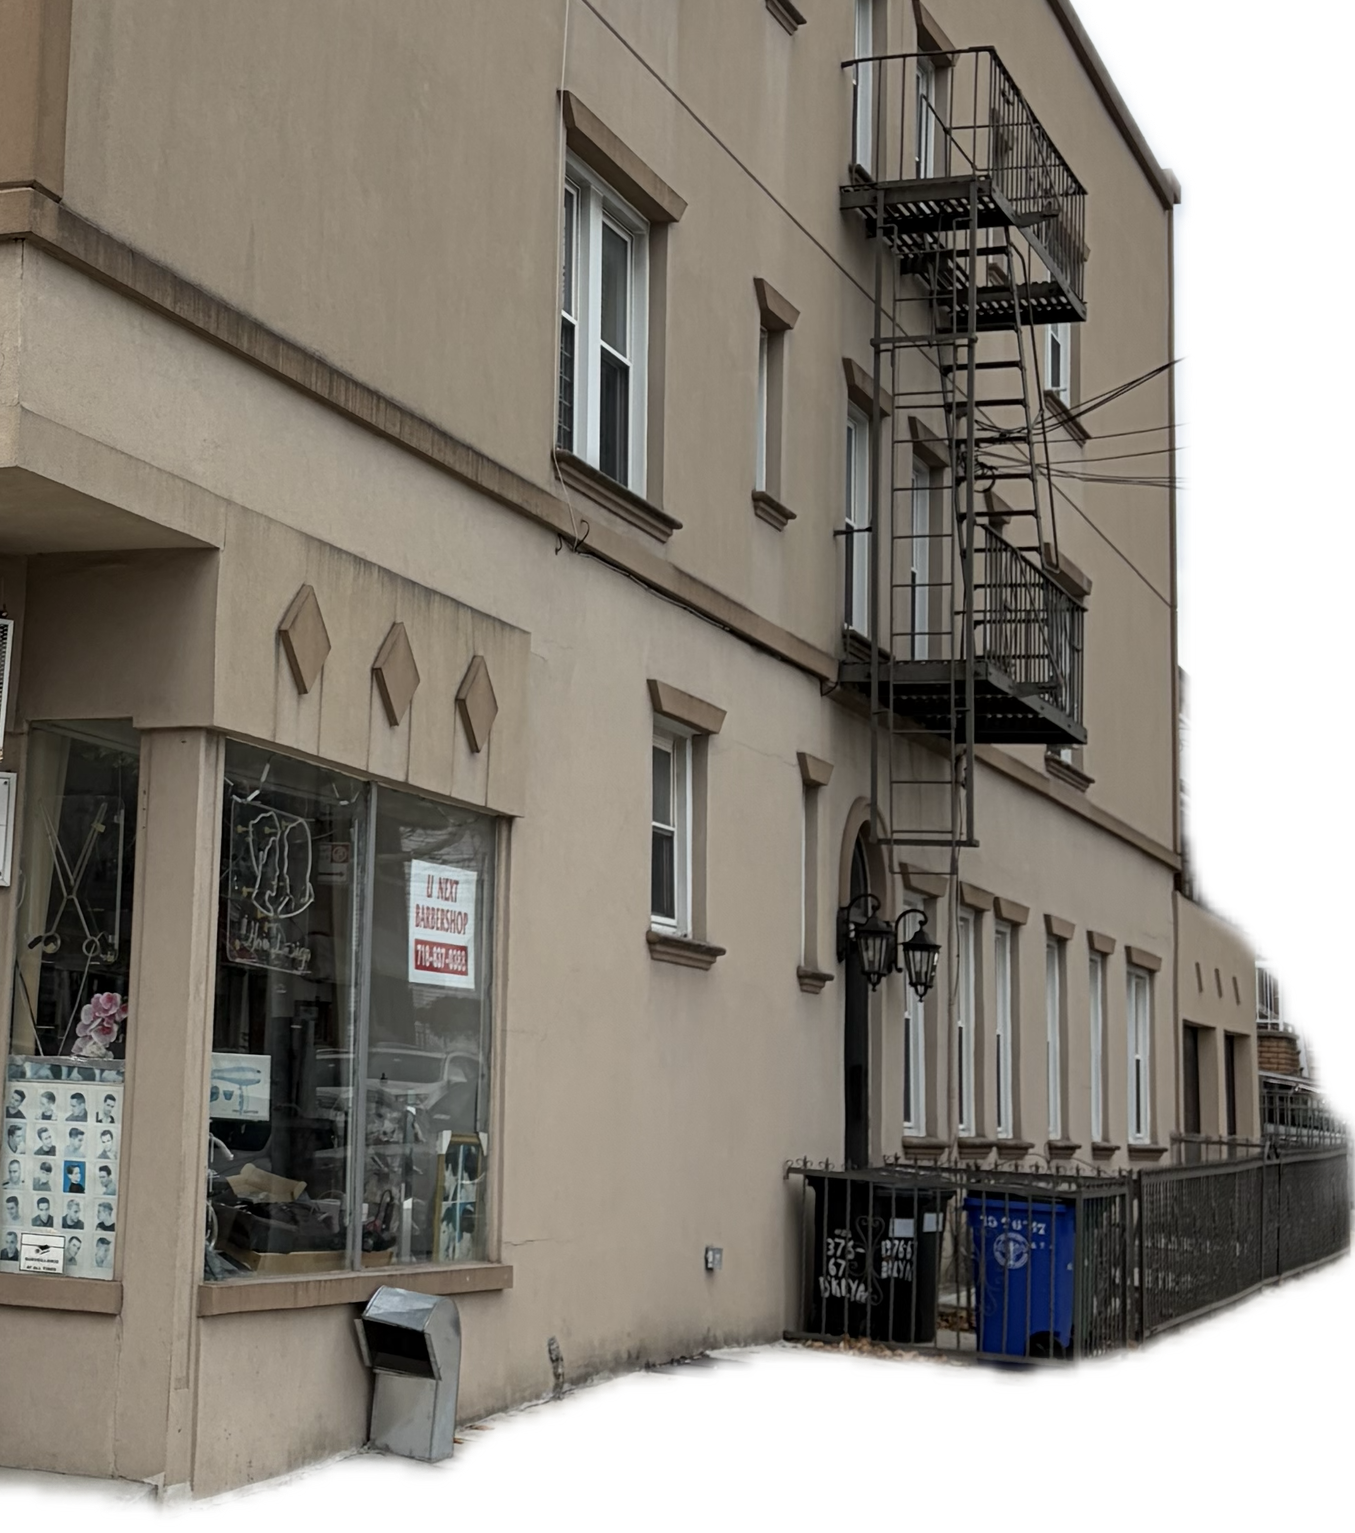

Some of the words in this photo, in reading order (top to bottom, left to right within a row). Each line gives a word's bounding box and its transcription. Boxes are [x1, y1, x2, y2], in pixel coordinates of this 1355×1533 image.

[426, 874, 434, 898] U
[437, 876, 459, 903] NEXT
[414, 903, 468, 935] BARBERSHOP
